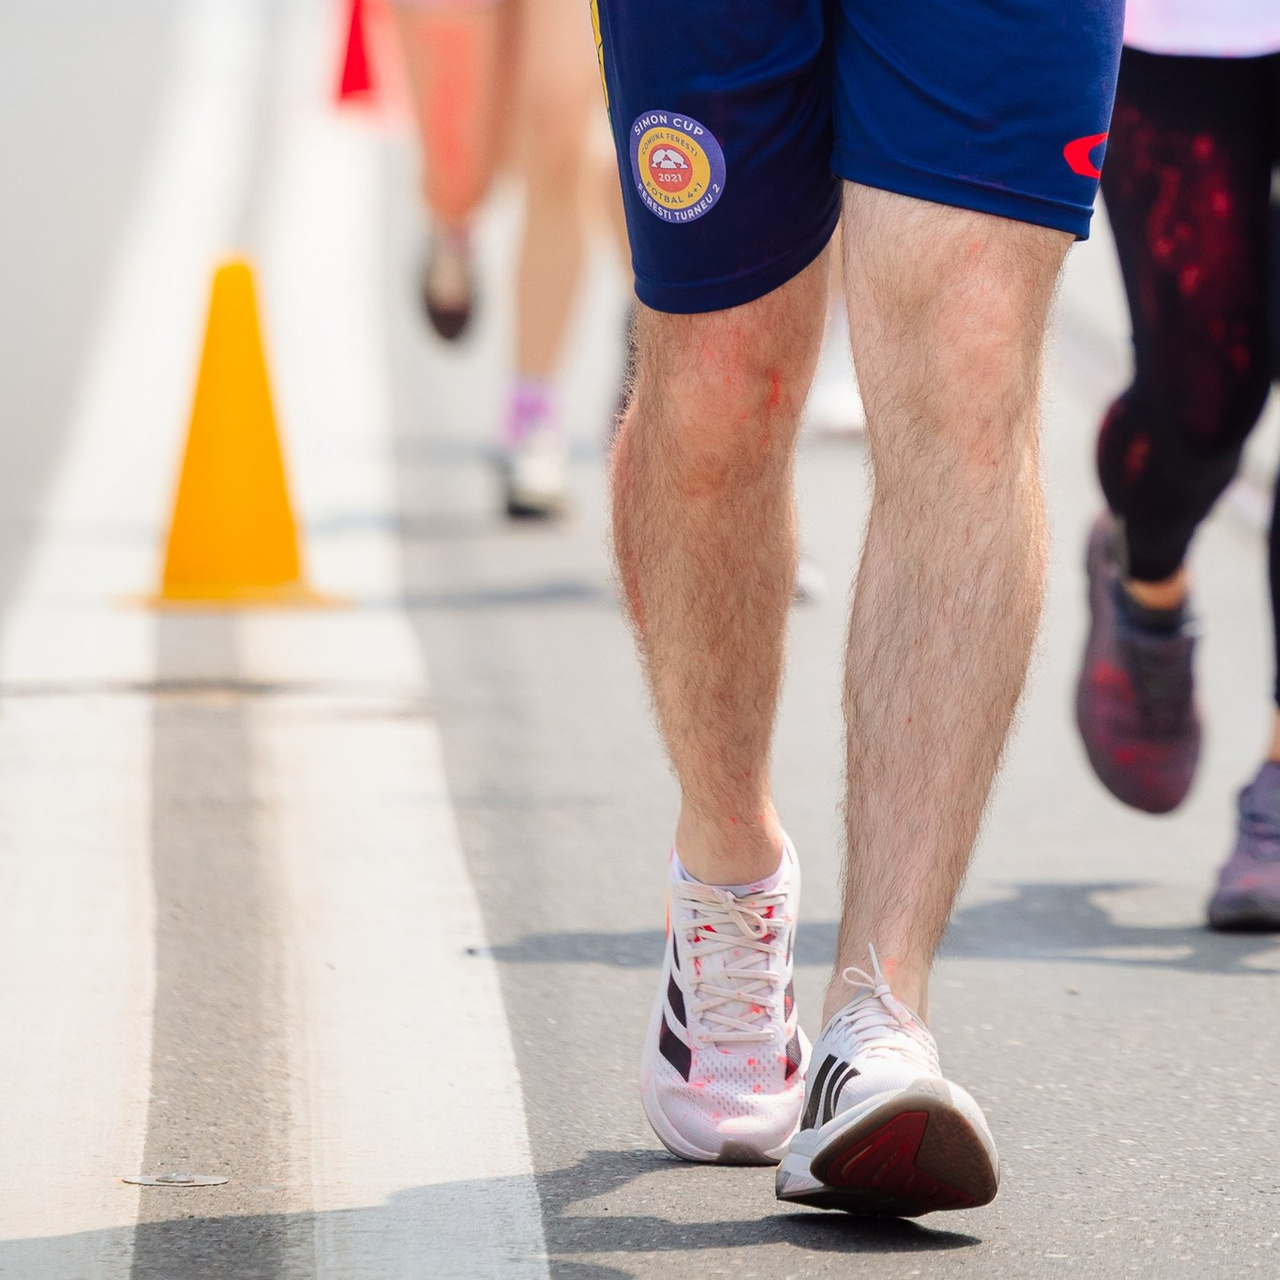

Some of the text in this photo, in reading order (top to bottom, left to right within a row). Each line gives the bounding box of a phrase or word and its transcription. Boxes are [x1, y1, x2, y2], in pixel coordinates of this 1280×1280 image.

[634, 115, 704, 137] SIMON CUP
[641, 132, 699, 158] COMUNA FERESTI
[658, 173, 683, 183] 2021
[637, 182, 721, 221] FERESTI TURNEU 2
[646, 181, 703, 204] FOTBAL 4+1
